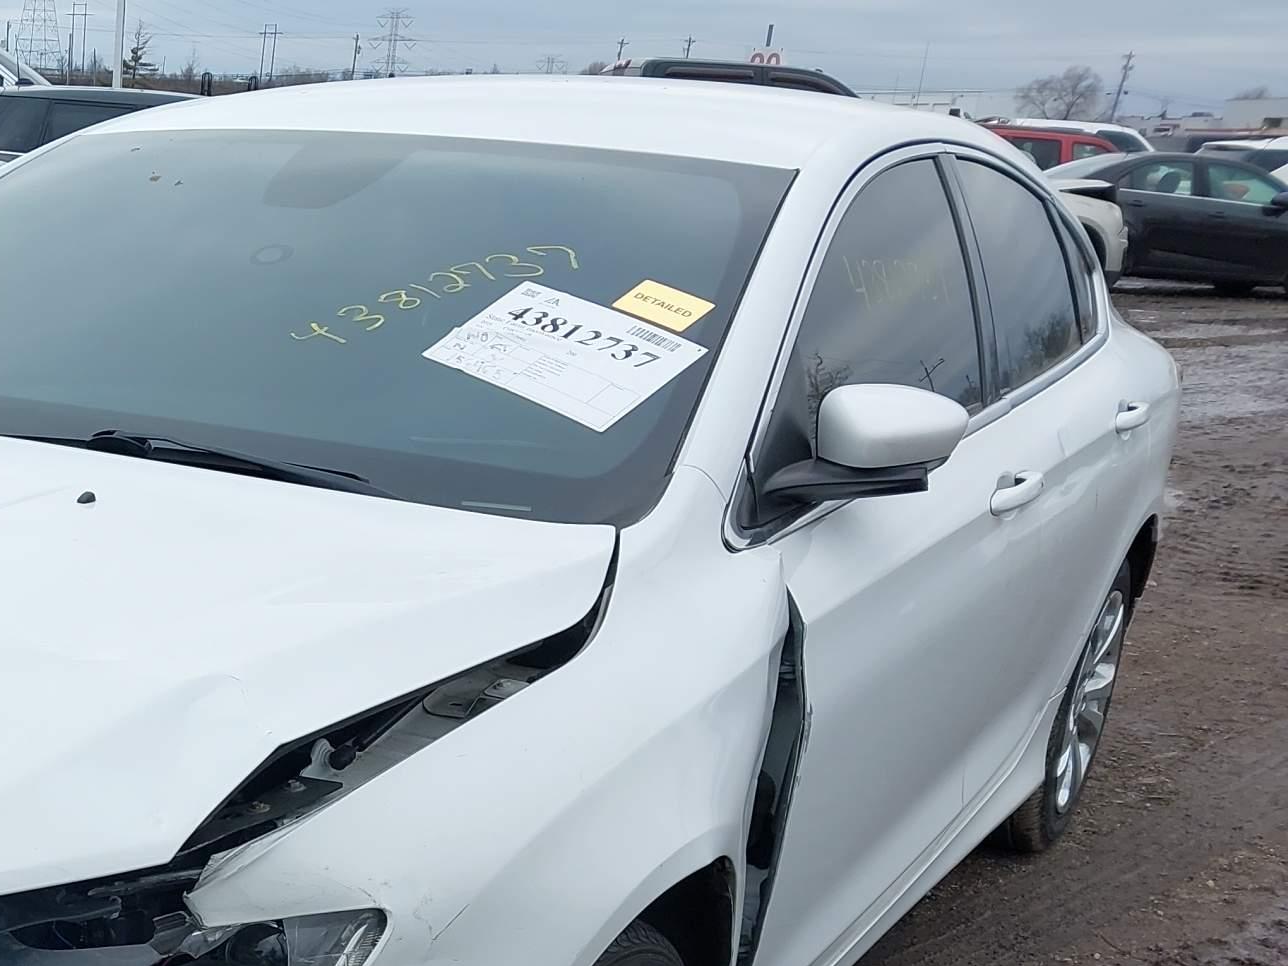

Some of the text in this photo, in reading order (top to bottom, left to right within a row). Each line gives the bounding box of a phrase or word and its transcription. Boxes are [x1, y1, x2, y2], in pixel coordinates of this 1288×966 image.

[289, 245, 580, 345] 43812737
[633, 291, 693, 319] DETAILED
[507, 306, 662, 369] 43812737
